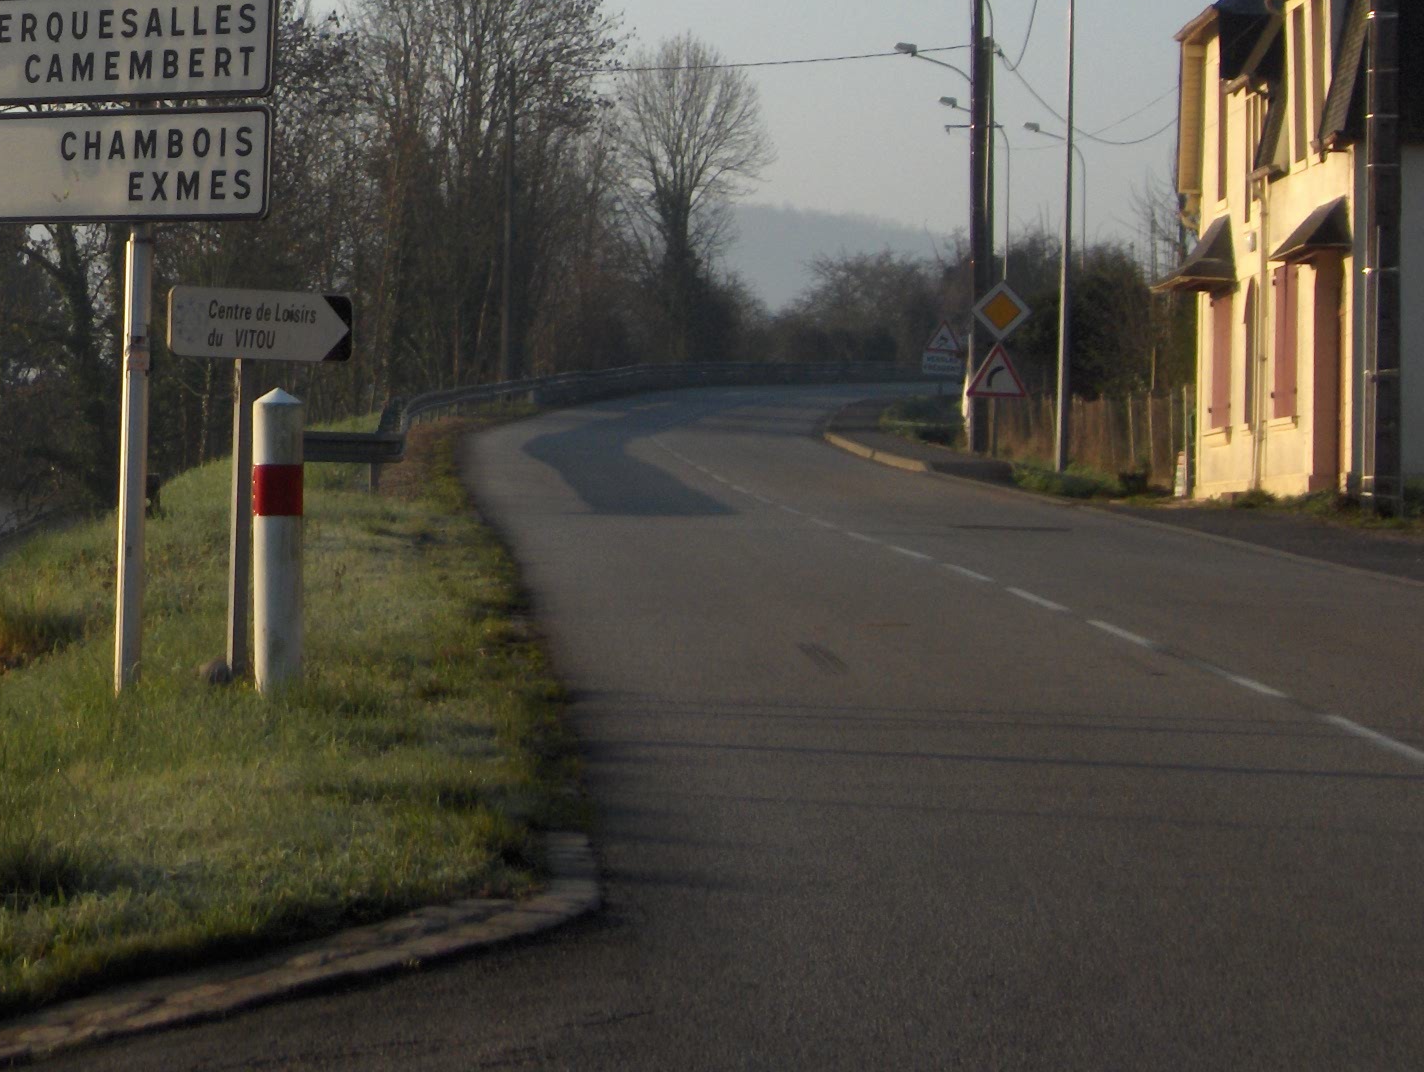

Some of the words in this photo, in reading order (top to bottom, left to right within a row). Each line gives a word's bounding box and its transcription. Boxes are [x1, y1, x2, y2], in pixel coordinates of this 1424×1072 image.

[24, 46, 256, 84] CAMEMBERT
[60, 126, 253, 161] CHAMBOIS
[128, 169, 251, 201] EXMES
[208, 299, 252, 320] Centre
[256, 303, 272, 321] de
[275, 303, 317, 324] Loisirs
[207, 328, 223, 347] du
[235, 329, 276, 349] VITOU
